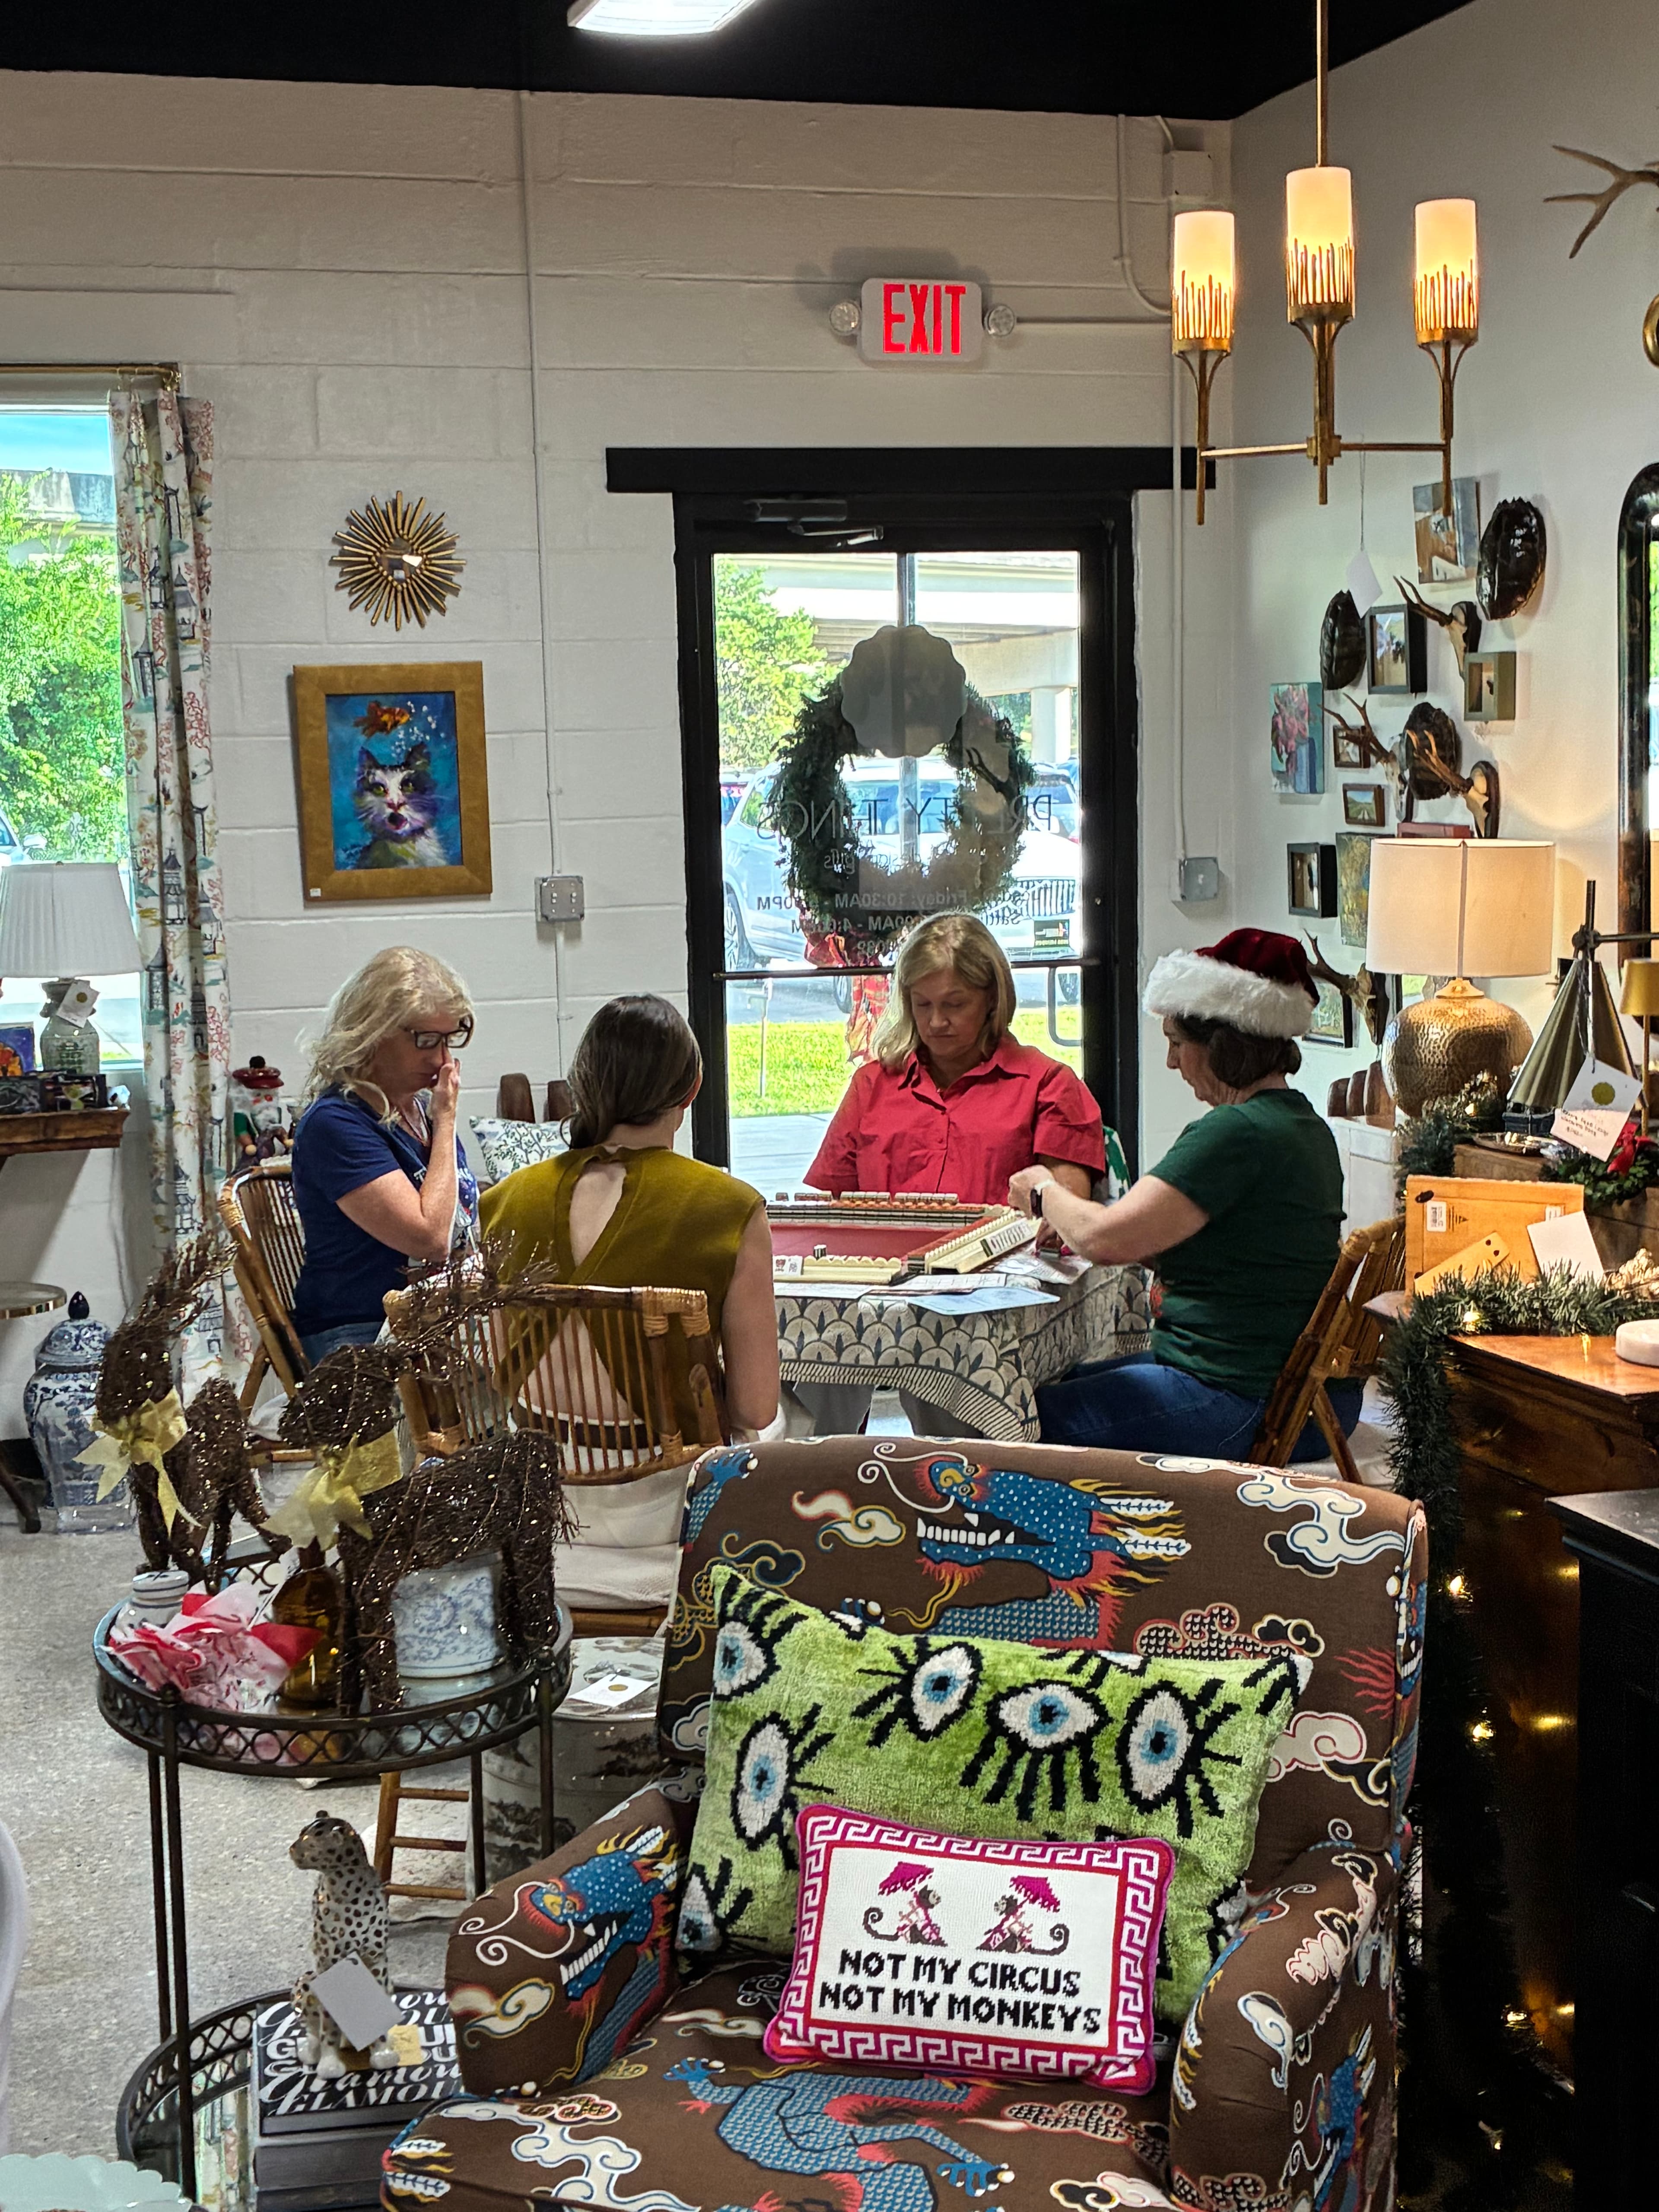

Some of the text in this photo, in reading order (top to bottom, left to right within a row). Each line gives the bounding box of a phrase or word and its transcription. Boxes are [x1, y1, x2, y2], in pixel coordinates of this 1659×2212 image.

[883, 283, 966, 355] EXIT
[838, 1949, 1081, 1996] NOT MY CIRCUS
[819, 1982, 1102, 2034] NOT MY MONKEYS
[260, 2063, 462, 2103] Glamou
[268, 2075, 458, 2116] GLAMOU
